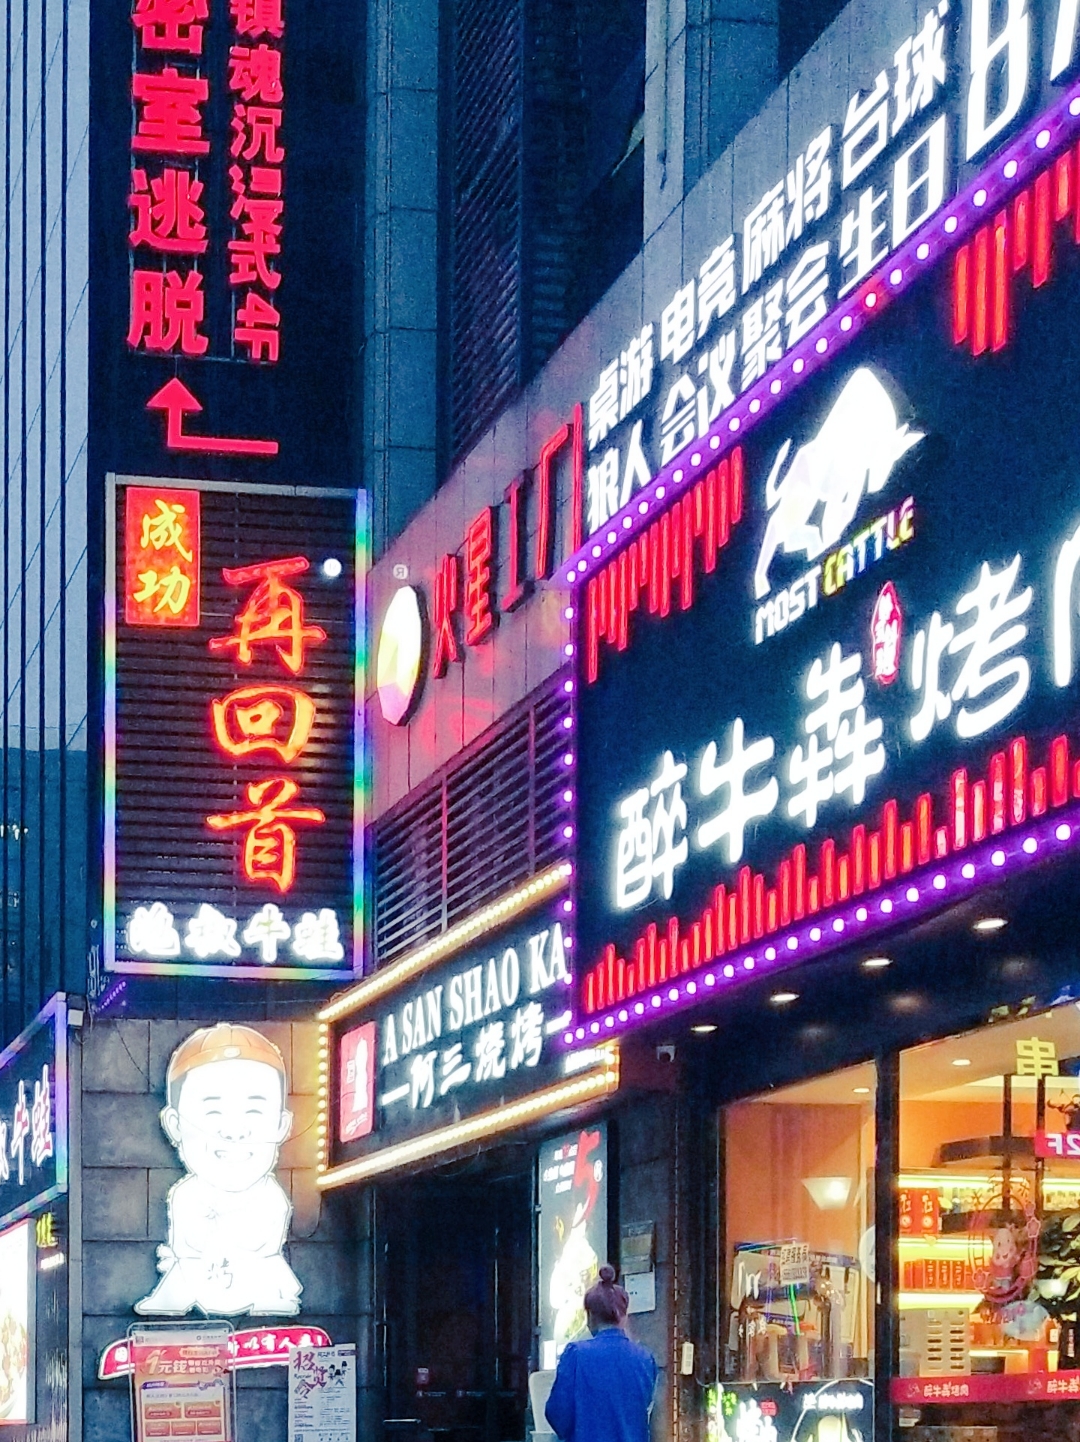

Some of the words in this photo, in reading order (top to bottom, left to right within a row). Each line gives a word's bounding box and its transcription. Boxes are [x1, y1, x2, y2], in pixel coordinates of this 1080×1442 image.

[128, 0, 210, 354] 密室逃脱
[588, 322, 654, 450] 桌游
[660, 233, 736, 365] 电竞
[741, 125, 832, 296] 麻将
[659, 333, 738, 467] 会议
[741, 240, 830, 391] 聚会
[837, 114, 948, 298] 生日
[132, 499, 194, 614] 成功
[755, 565, 822, 645] MOST
[822, 496, 915, 597] CATTLE
[207, 556, 327, 894] 再回首
[383, 1013, 399, 1066] A
[402, 985, 444, 1056] SAN
[449, 948, 520, 1031] SHAO
[528, 922, 568, 994] KA
